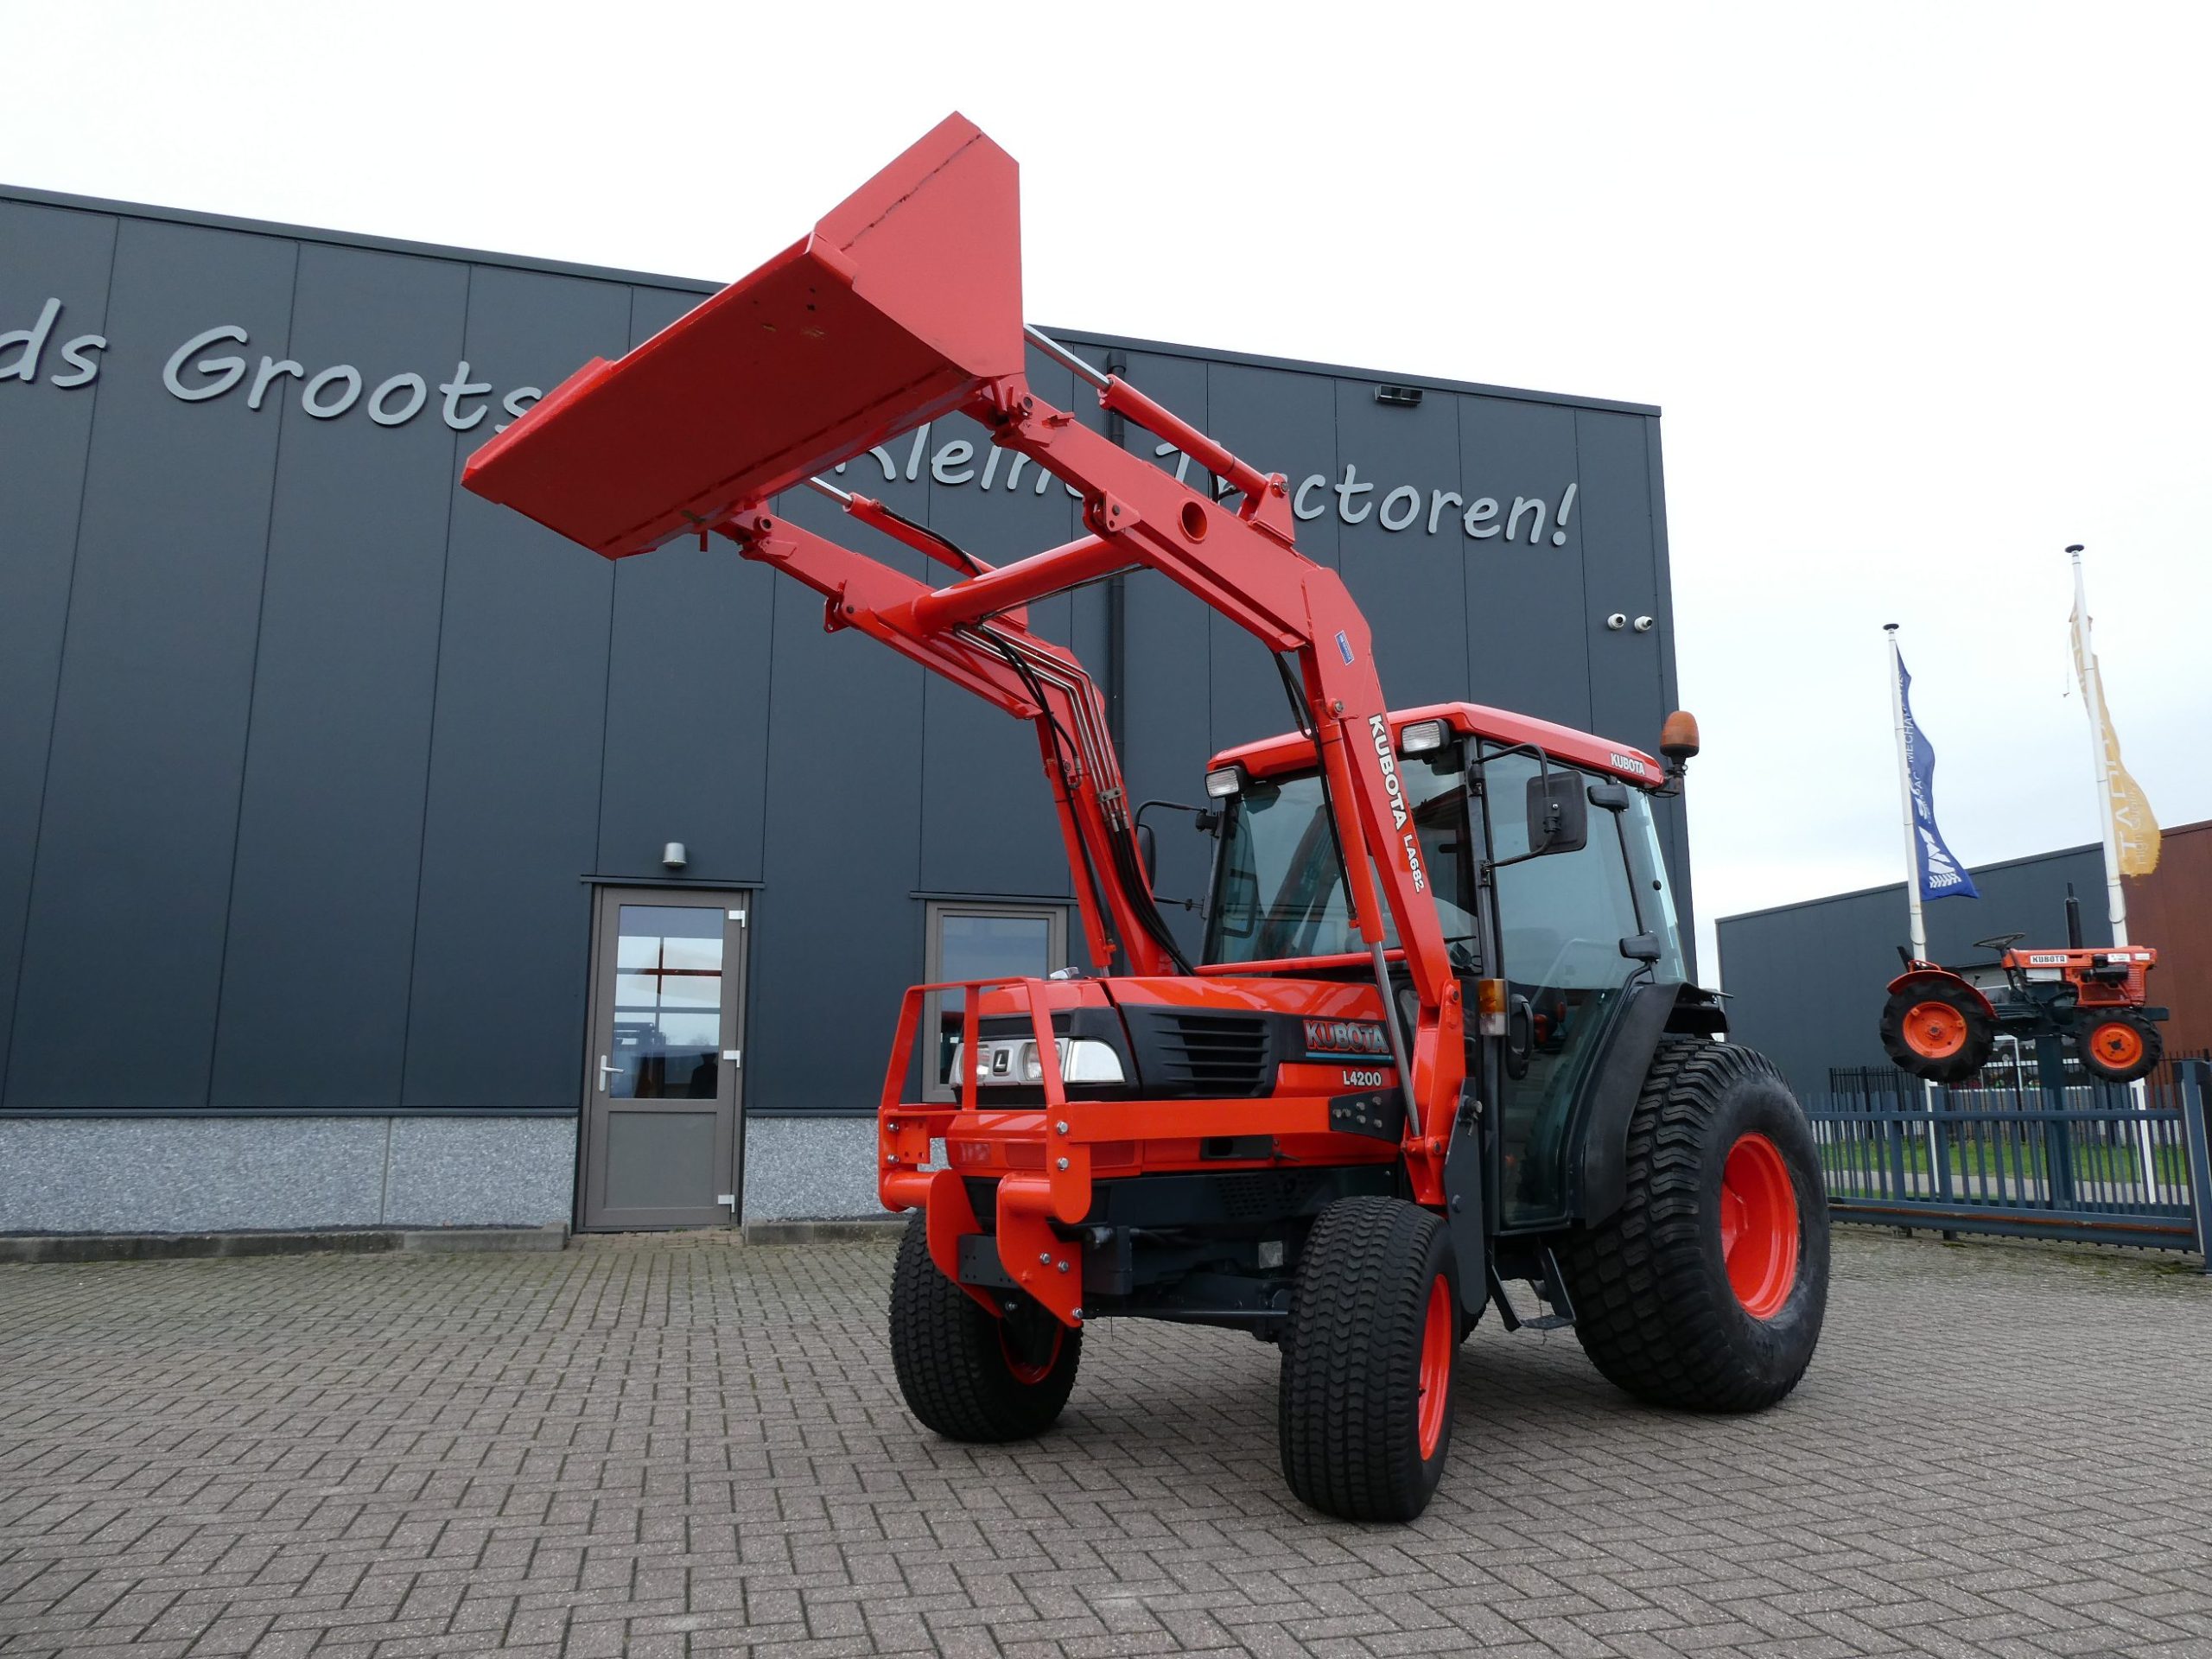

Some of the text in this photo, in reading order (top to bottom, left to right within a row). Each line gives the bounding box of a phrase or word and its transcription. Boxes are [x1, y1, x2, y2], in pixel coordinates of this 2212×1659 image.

[162, 324, 543, 435] Groots
[1610, 752, 1645, 776] KUBOTA
[1368, 714, 1426, 893] KUBOTA LA682
[1303, 1020, 1390, 1053] KUBOTA
[995, 1053, 1007, 1068] L
[1342, 1070, 1382, 1087] L4200
